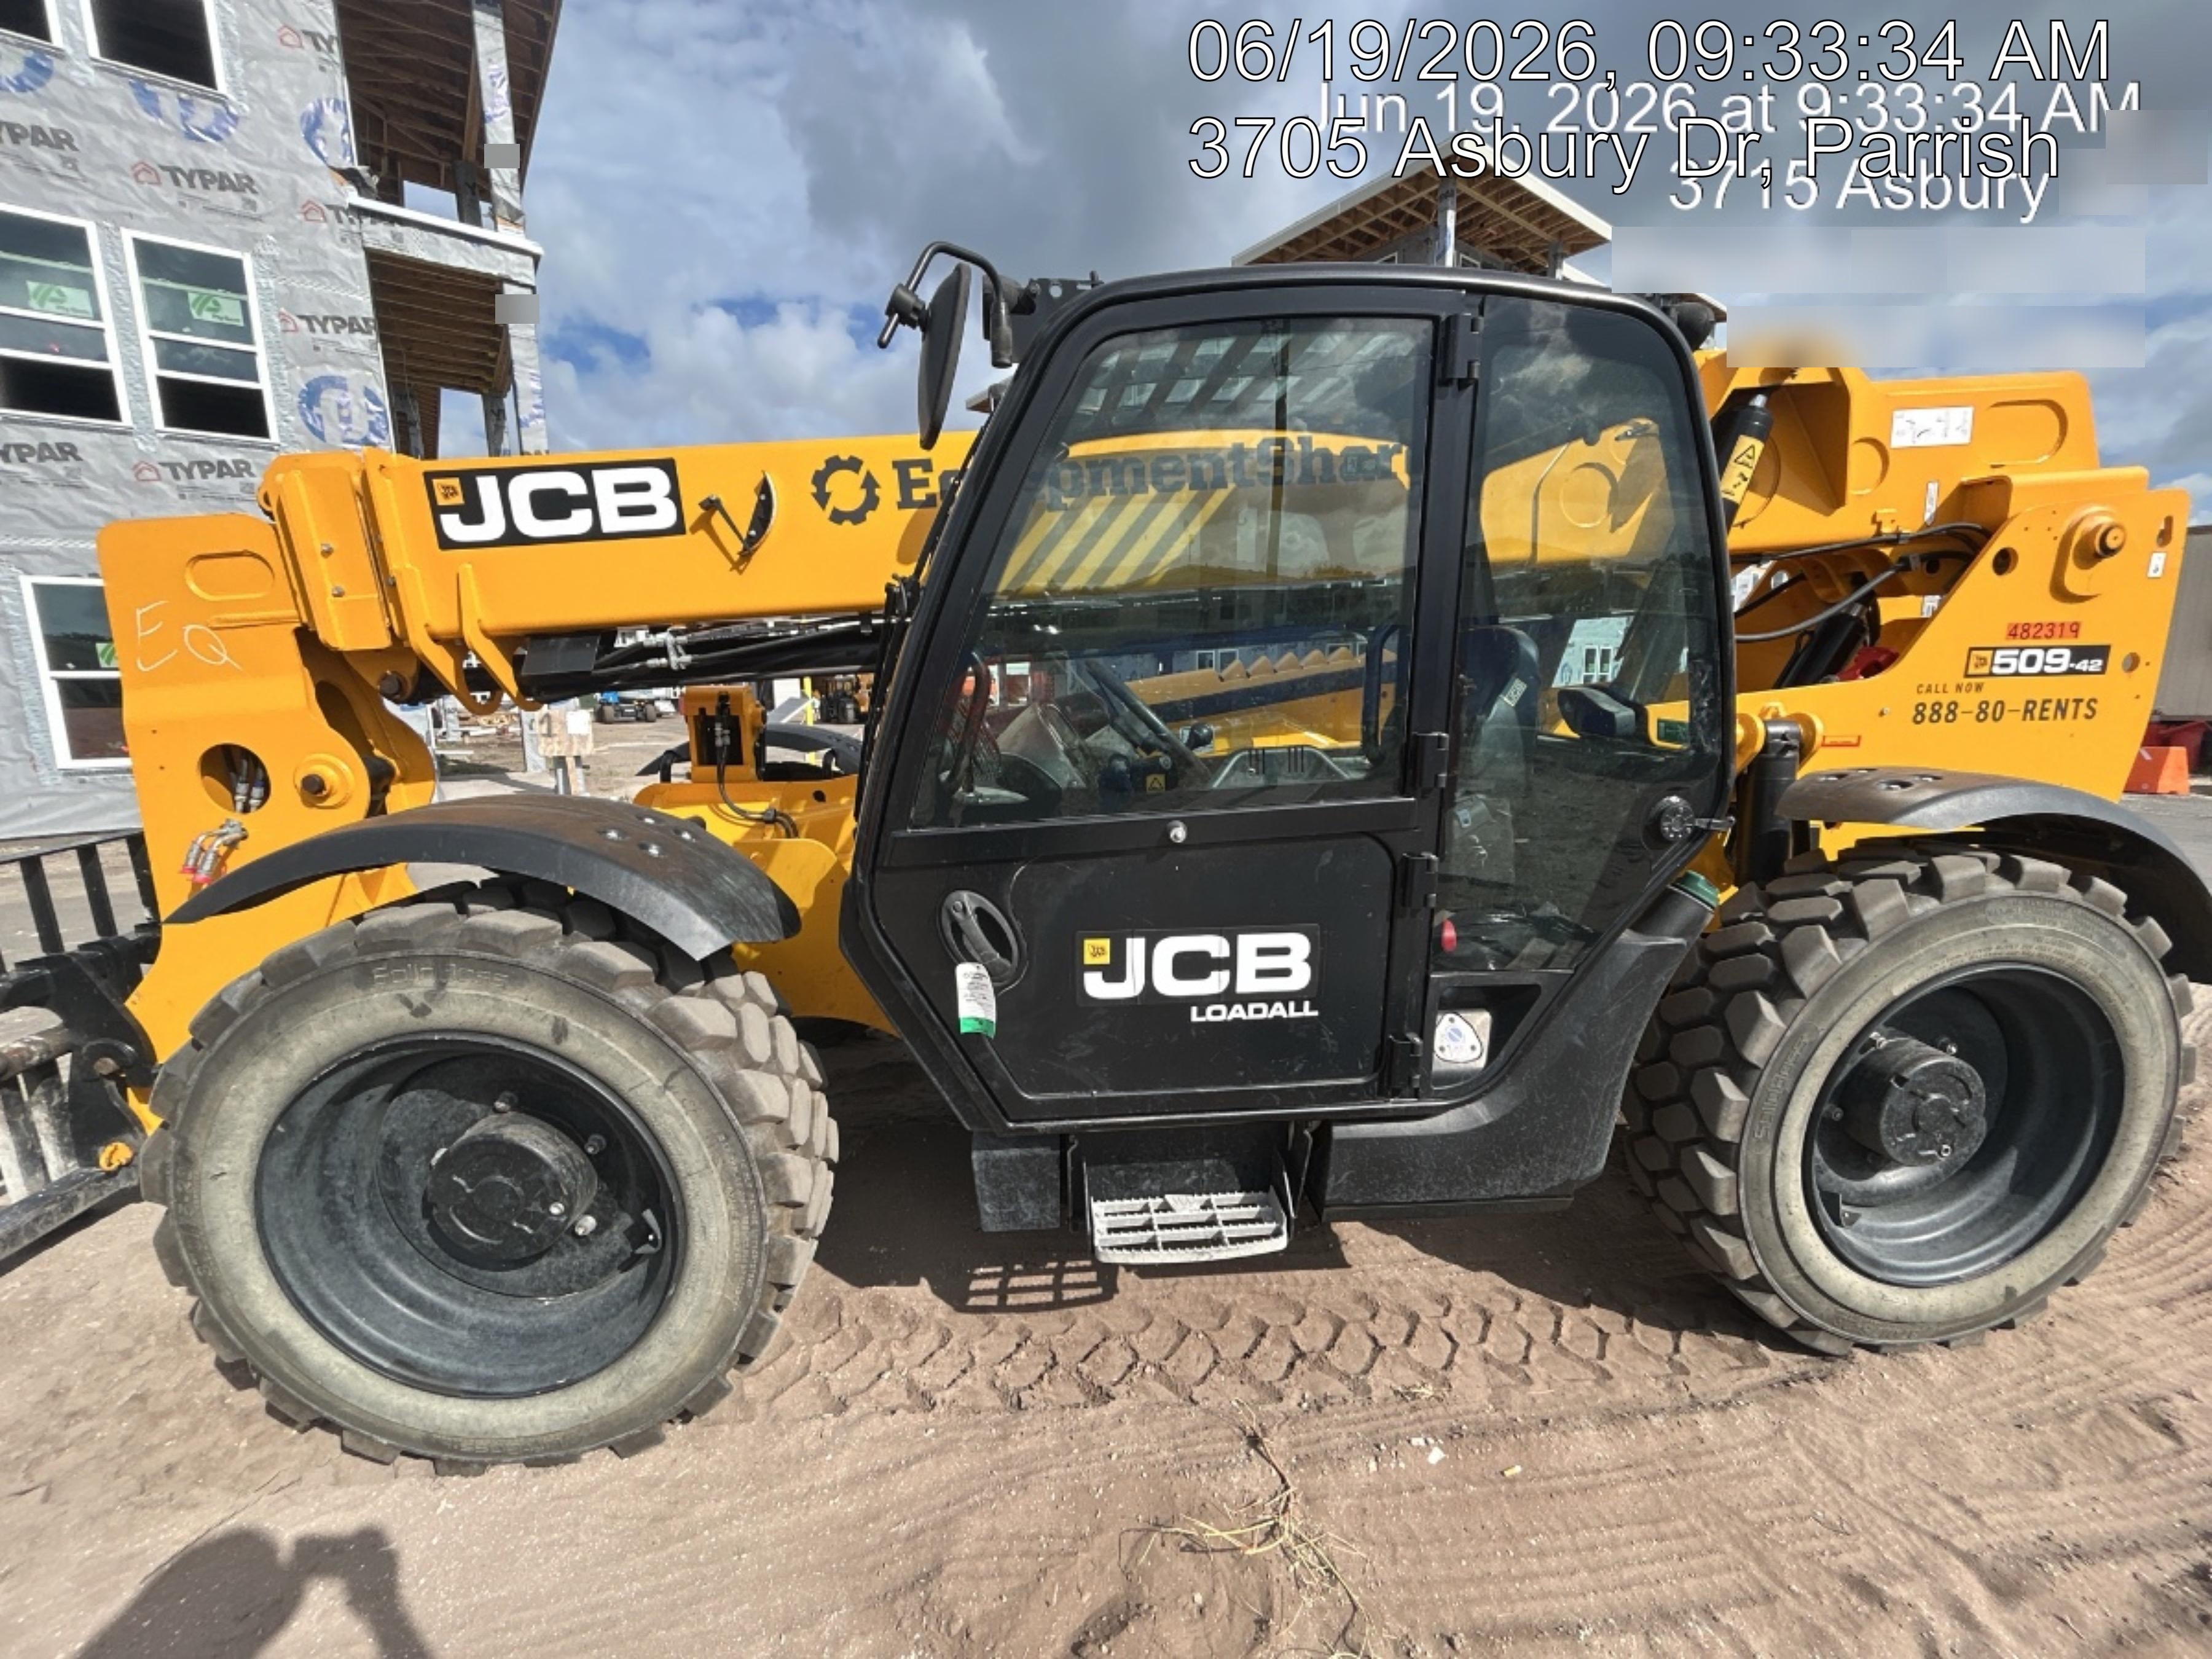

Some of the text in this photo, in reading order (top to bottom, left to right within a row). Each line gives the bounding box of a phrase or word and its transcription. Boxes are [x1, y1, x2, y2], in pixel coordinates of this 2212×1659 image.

[158, 165, 259, 194] TYPAR
[0, 442, 84, 463] YPAR
[158, 460, 257, 480] TYPAR
[440, 466, 677, 543] JCB
[2007, 621, 2081, 640] 482319
[1991, 648, 2104, 674] 509-42
[1916, 682, 1985, 694] CALL NOW
[1913, 697, 2099, 725] 888-80-RENTS
[1083, 932, 1311, 1000] JCB
[1190, 1000, 1319, 1022] LOADALL
